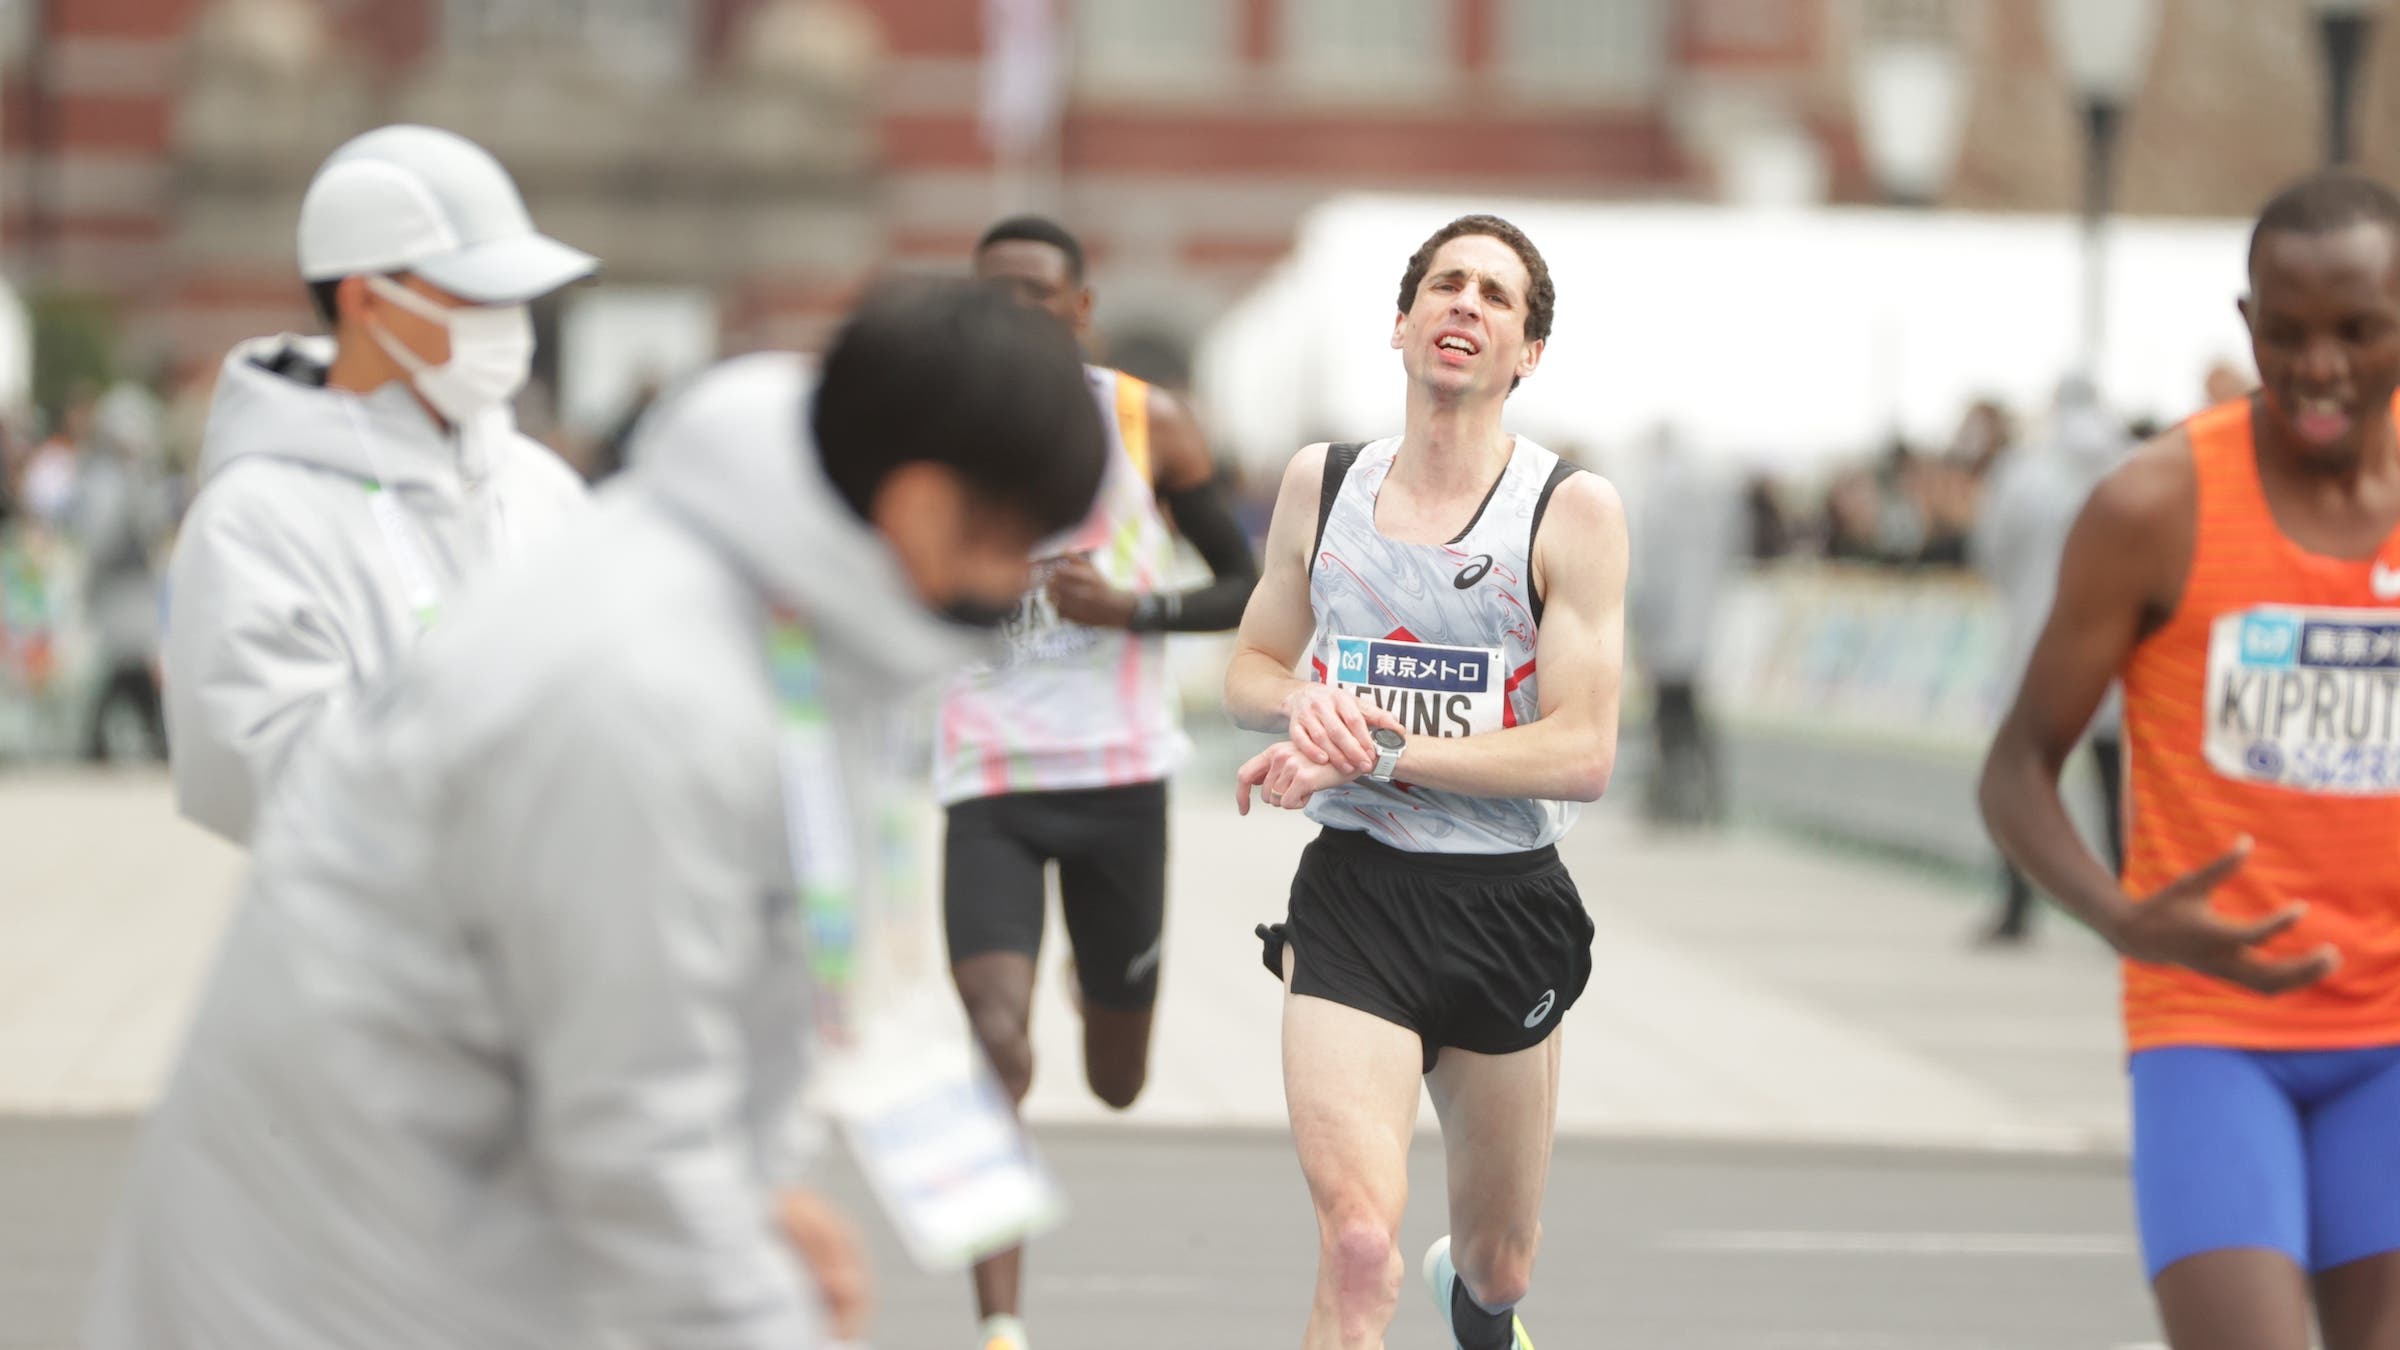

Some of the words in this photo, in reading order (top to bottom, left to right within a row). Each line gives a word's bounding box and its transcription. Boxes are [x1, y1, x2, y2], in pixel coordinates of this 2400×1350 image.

[1375, 654, 1480, 682] 東京メトロ
